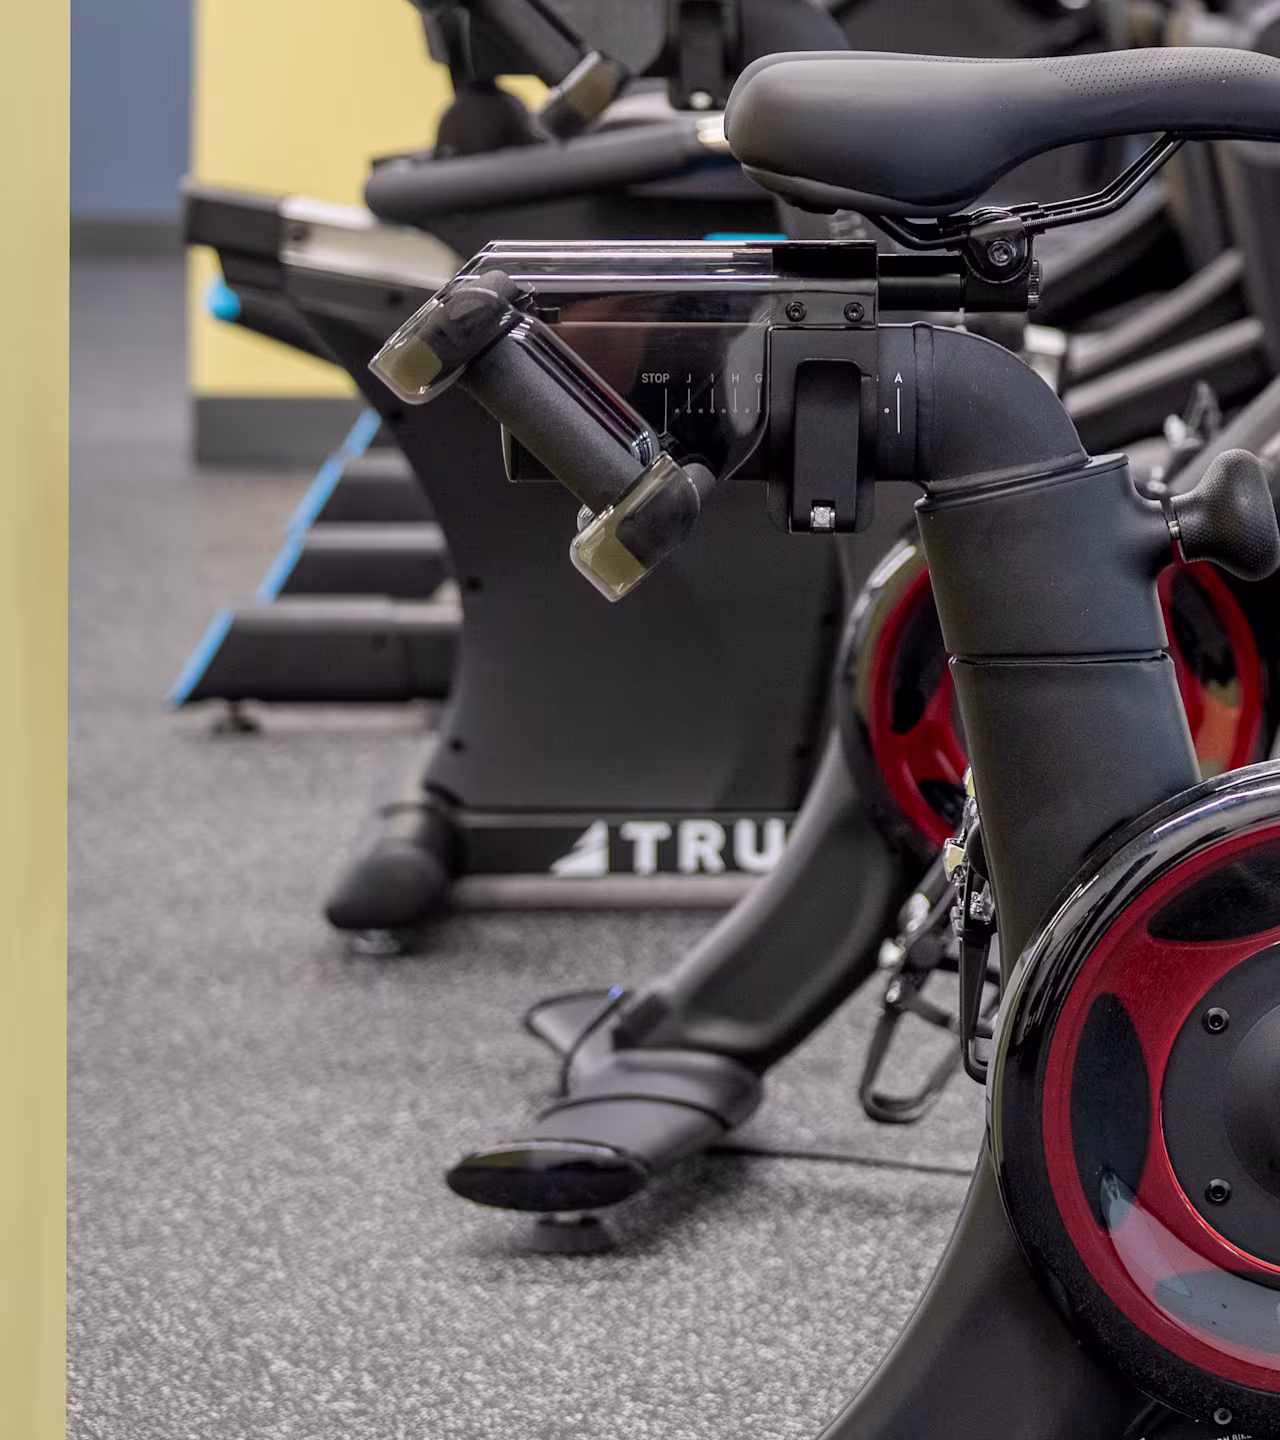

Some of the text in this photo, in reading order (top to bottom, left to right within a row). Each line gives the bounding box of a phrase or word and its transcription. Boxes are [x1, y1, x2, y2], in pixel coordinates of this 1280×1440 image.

[641, 372, 670, 384] STOP
[686, 373, 692, 384] J
[731, 373, 740, 384] H
[755, 373, 763, 384] G
[894, 371, 903, 384] A
